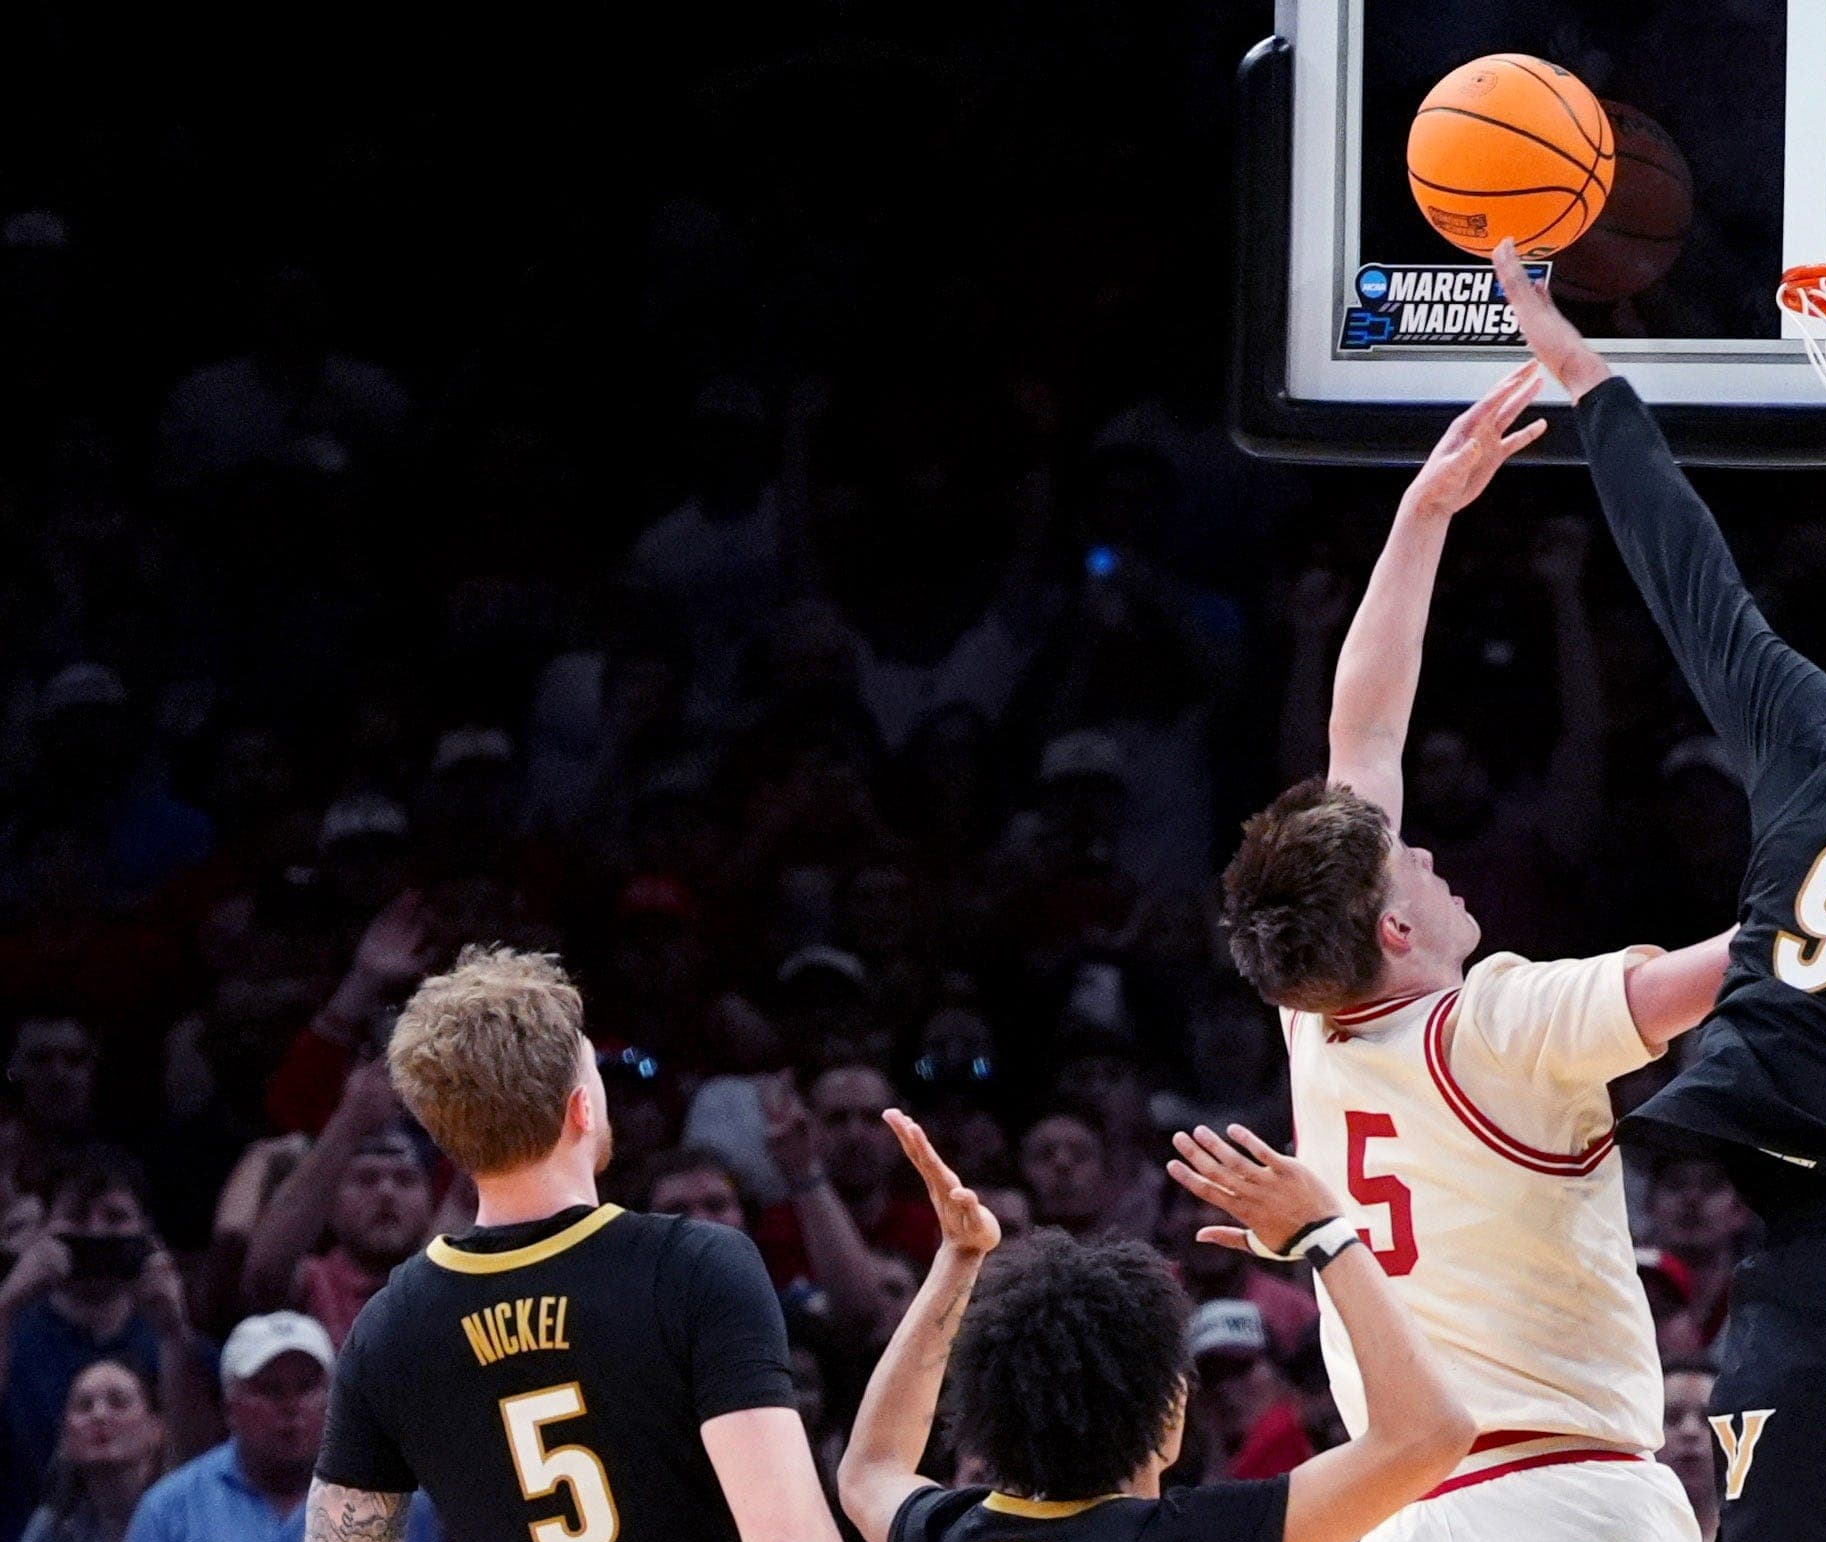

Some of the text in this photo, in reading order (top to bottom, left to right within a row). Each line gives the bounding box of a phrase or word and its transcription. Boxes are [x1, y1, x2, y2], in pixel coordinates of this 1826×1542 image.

[1387, 271, 1493, 302] MARCH
[1399, 303, 1524, 334] MADNES
[1345, 1111, 1419, 1277] 5
[461, 1296, 570, 1366] NICKEL
[1708, 1408, 1776, 1500] V
